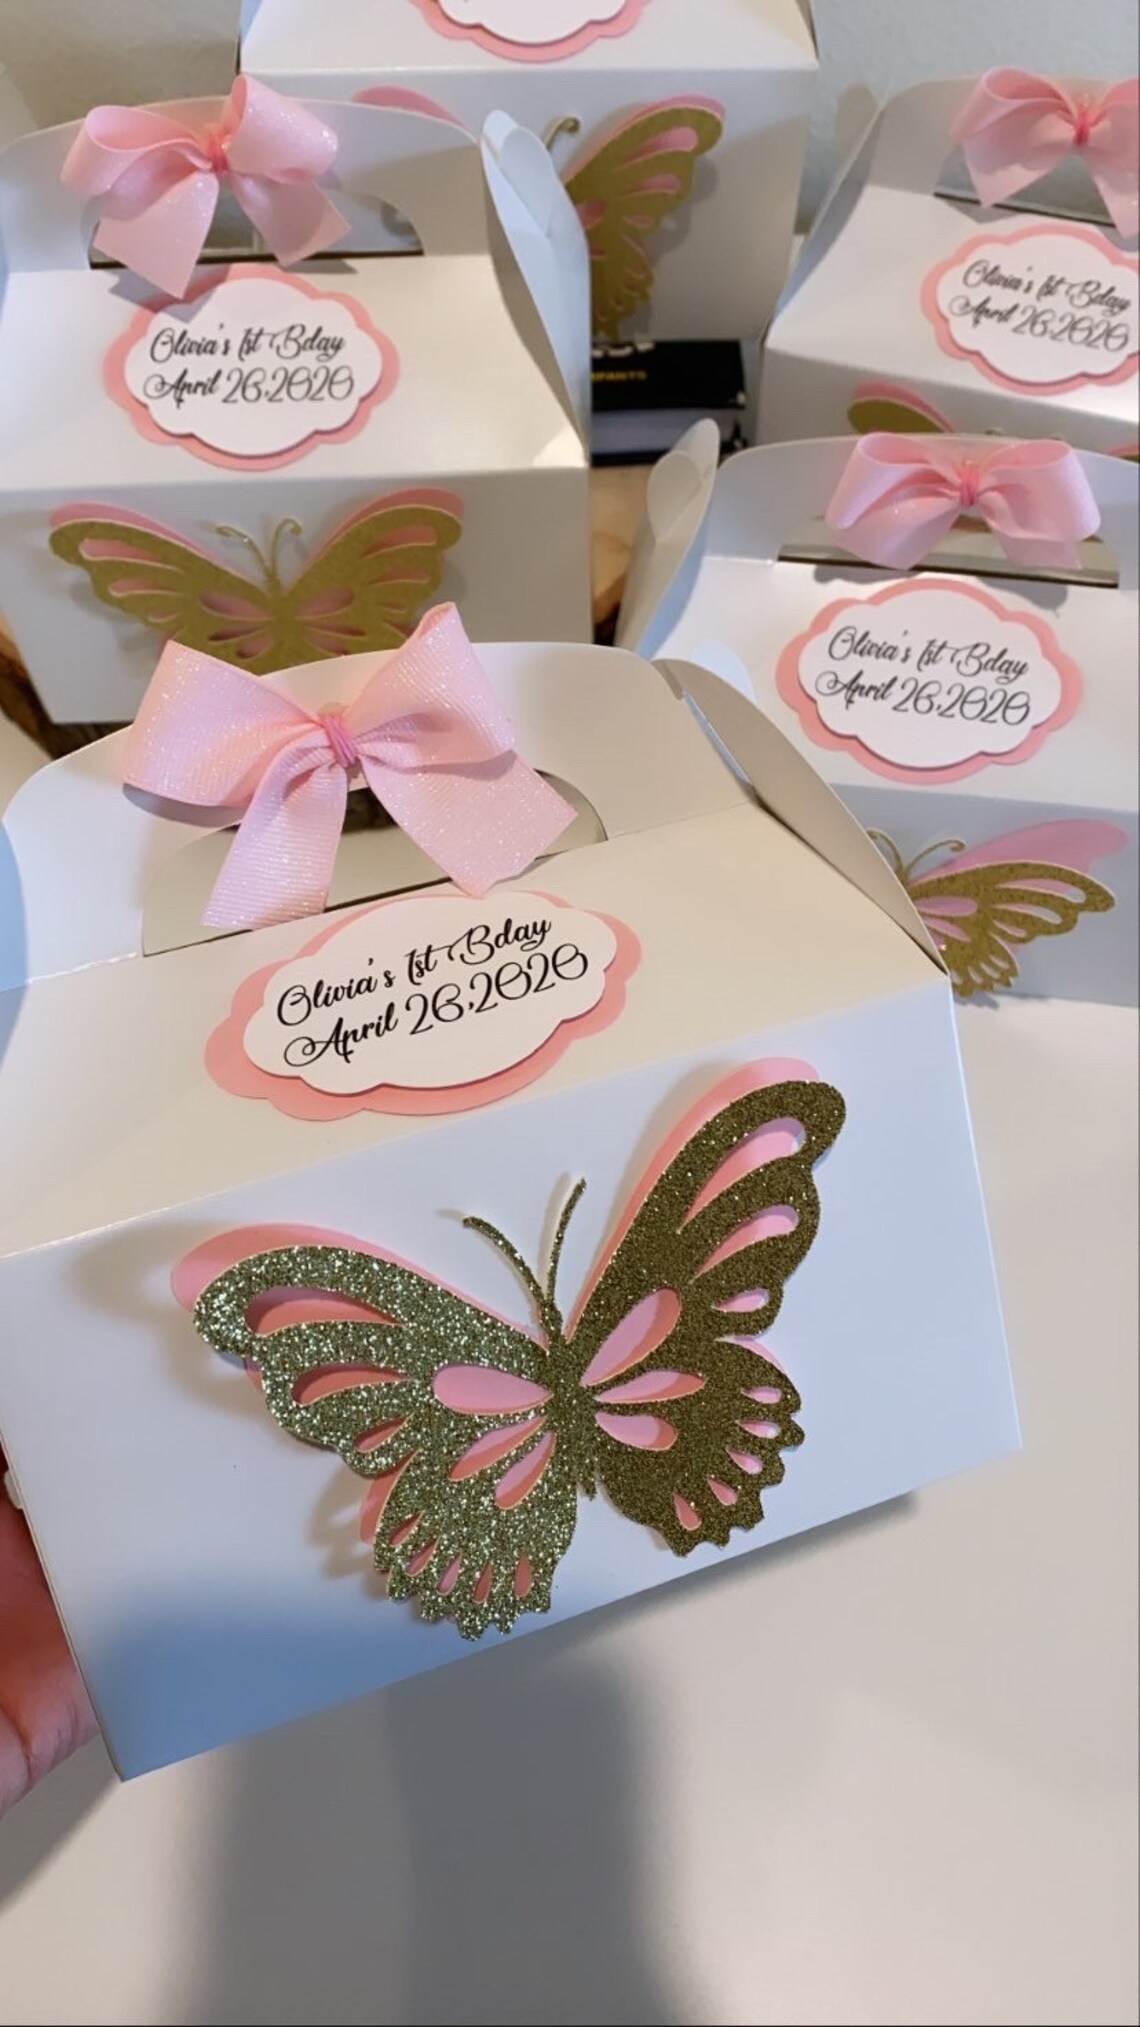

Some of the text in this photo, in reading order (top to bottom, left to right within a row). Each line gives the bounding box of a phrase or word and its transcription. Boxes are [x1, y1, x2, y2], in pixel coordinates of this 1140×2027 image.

[949, 295, 1020, 329] April
[962, 259, 1034, 294] Olivia's
[1065, 279, 1131, 317] Bday
[150, 322, 231, 363] Olivia's
[267, 323, 346, 363] Bday
[143, 368, 222, 409] April
[828, 625, 911, 663] Olivia's
[950, 641, 1028, 685] Bday
[815, 669, 898, 710] April
[277, 957, 396, 1027] Olivia's
[446, 917, 552, 966] Bday
[284, 1001, 399, 1068] April
